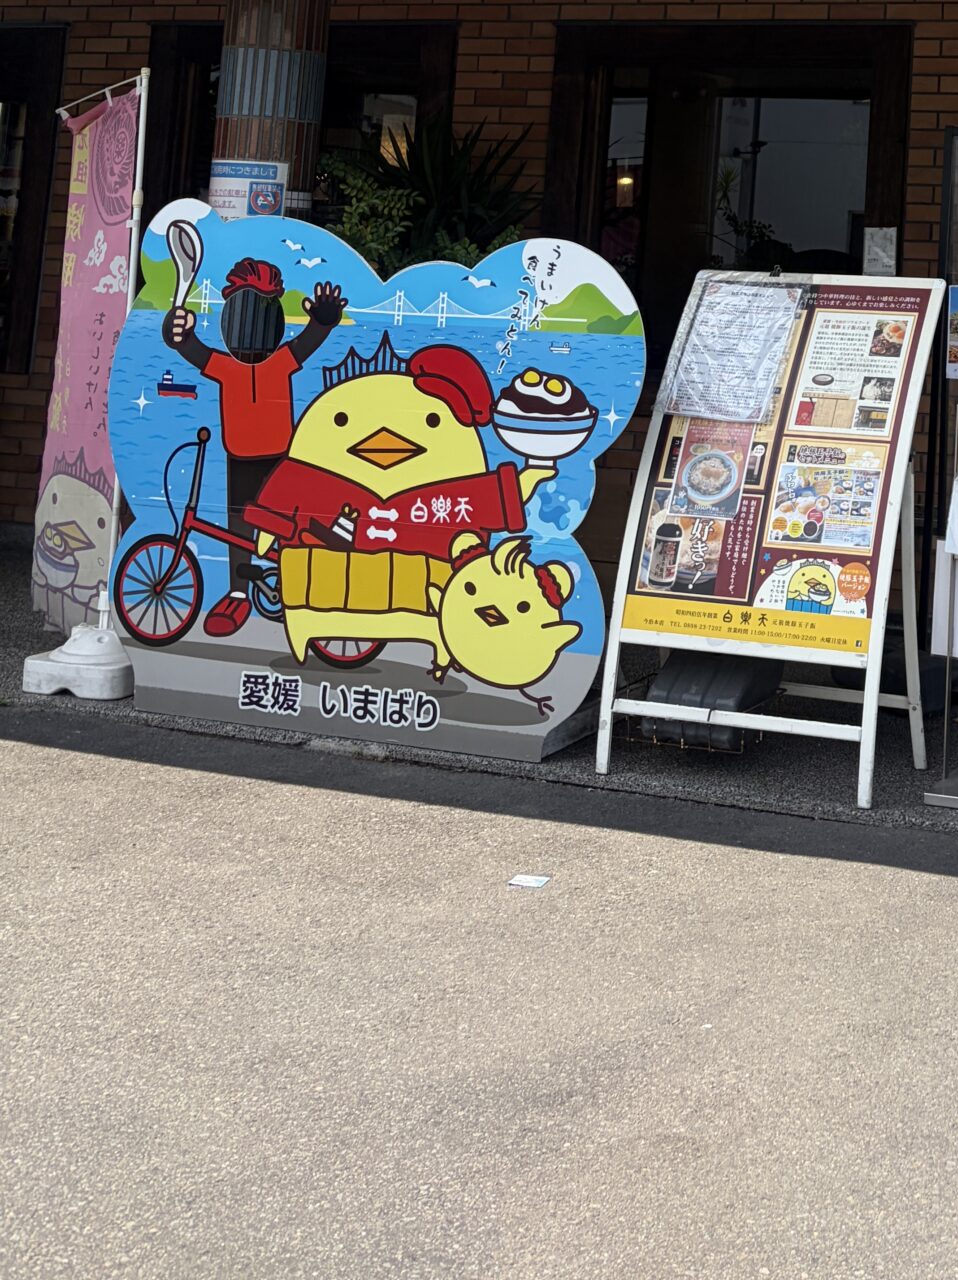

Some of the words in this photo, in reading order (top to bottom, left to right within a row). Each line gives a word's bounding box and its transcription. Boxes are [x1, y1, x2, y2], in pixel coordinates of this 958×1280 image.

[530, 245, 561, 329] うまいけん
[240, 672, 301, 714] 愛媛
[320, 682, 440, 730] いまばり
